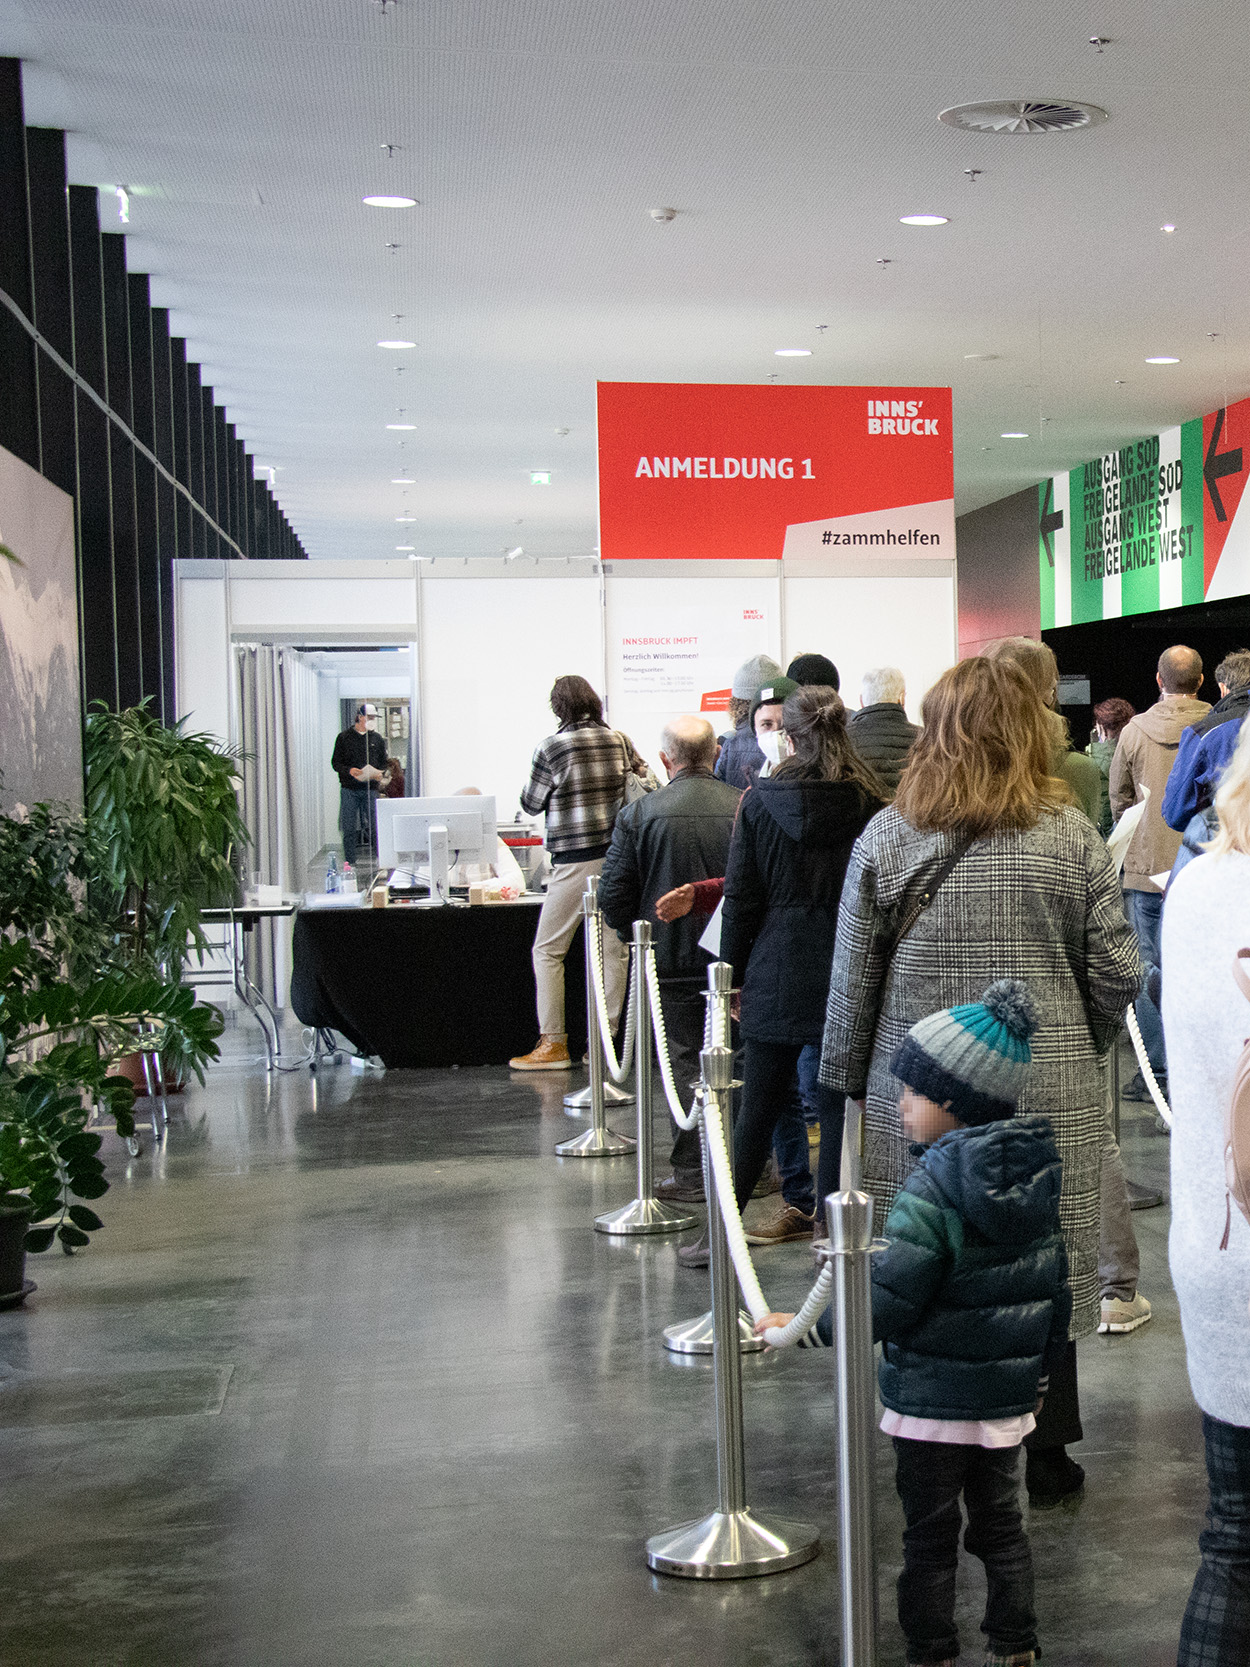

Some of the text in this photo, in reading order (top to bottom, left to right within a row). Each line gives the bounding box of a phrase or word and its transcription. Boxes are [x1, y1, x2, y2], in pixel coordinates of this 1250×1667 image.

[868, 418, 940, 436] BRUCK
[635, 456, 816, 480] ANMELDUNG 1
[1084, 435, 1160, 492] AUSGANG SÜD
[1084, 459, 1183, 522] FREIGELÄNDE SÜD
[822, 528, 941, 546] #zammhelfen
[1085, 498, 1170, 552] AUSGANG WEST
[1085, 524, 1194, 581] FREIGELÄNDE WEST
[622, 636, 699, 646] INNSBRUCK IMPFT
[622, 652, 699, 661] Herzlich Willkommen!
